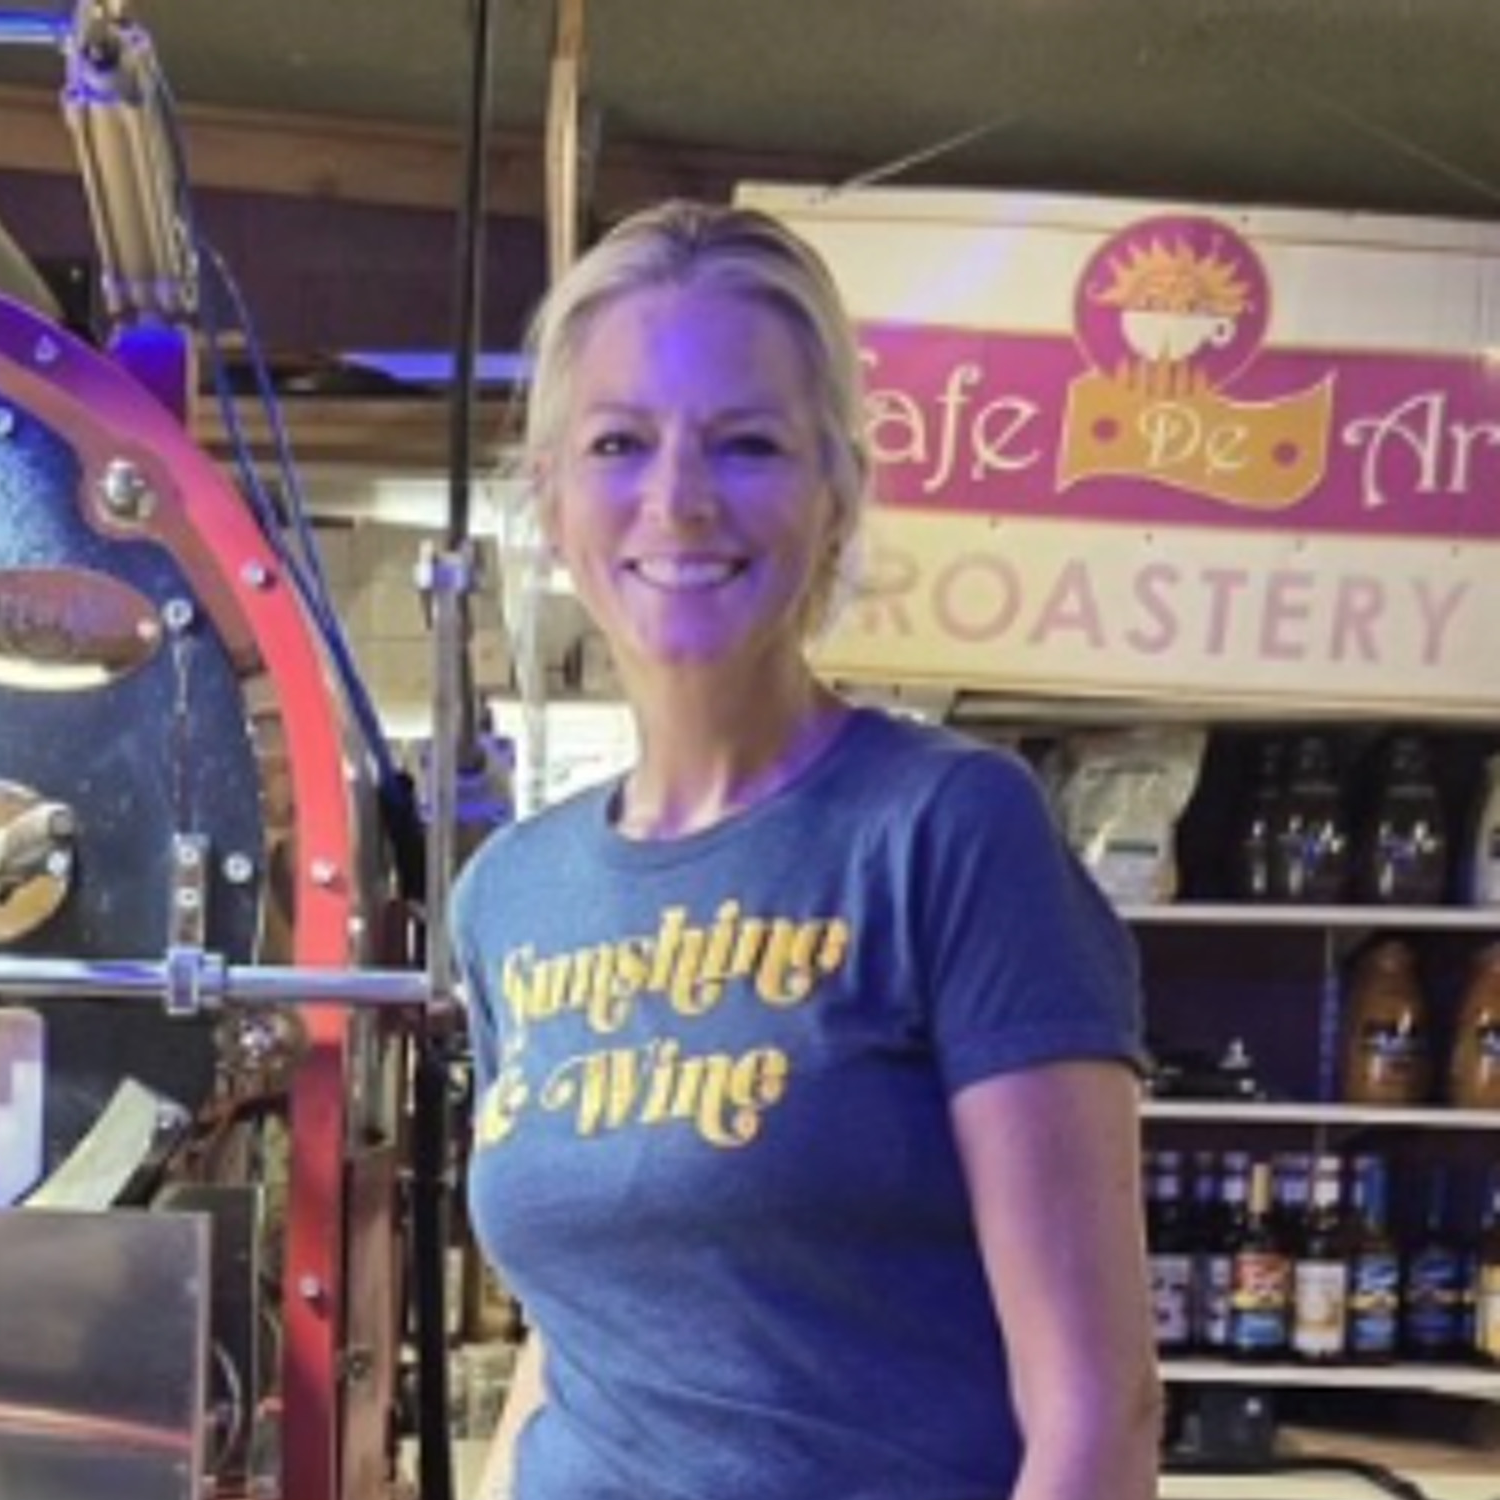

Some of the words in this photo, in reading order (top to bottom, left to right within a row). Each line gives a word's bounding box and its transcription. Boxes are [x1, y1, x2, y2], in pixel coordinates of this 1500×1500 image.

[857, 348, 1041, 494] afe
[1138, 402, 1250, 473] De
[858, 548, 1471, 668] ROASTERY
[502, 898, 849, 1046] Sunshine
[540, 1037, 789, 1148] Wine
